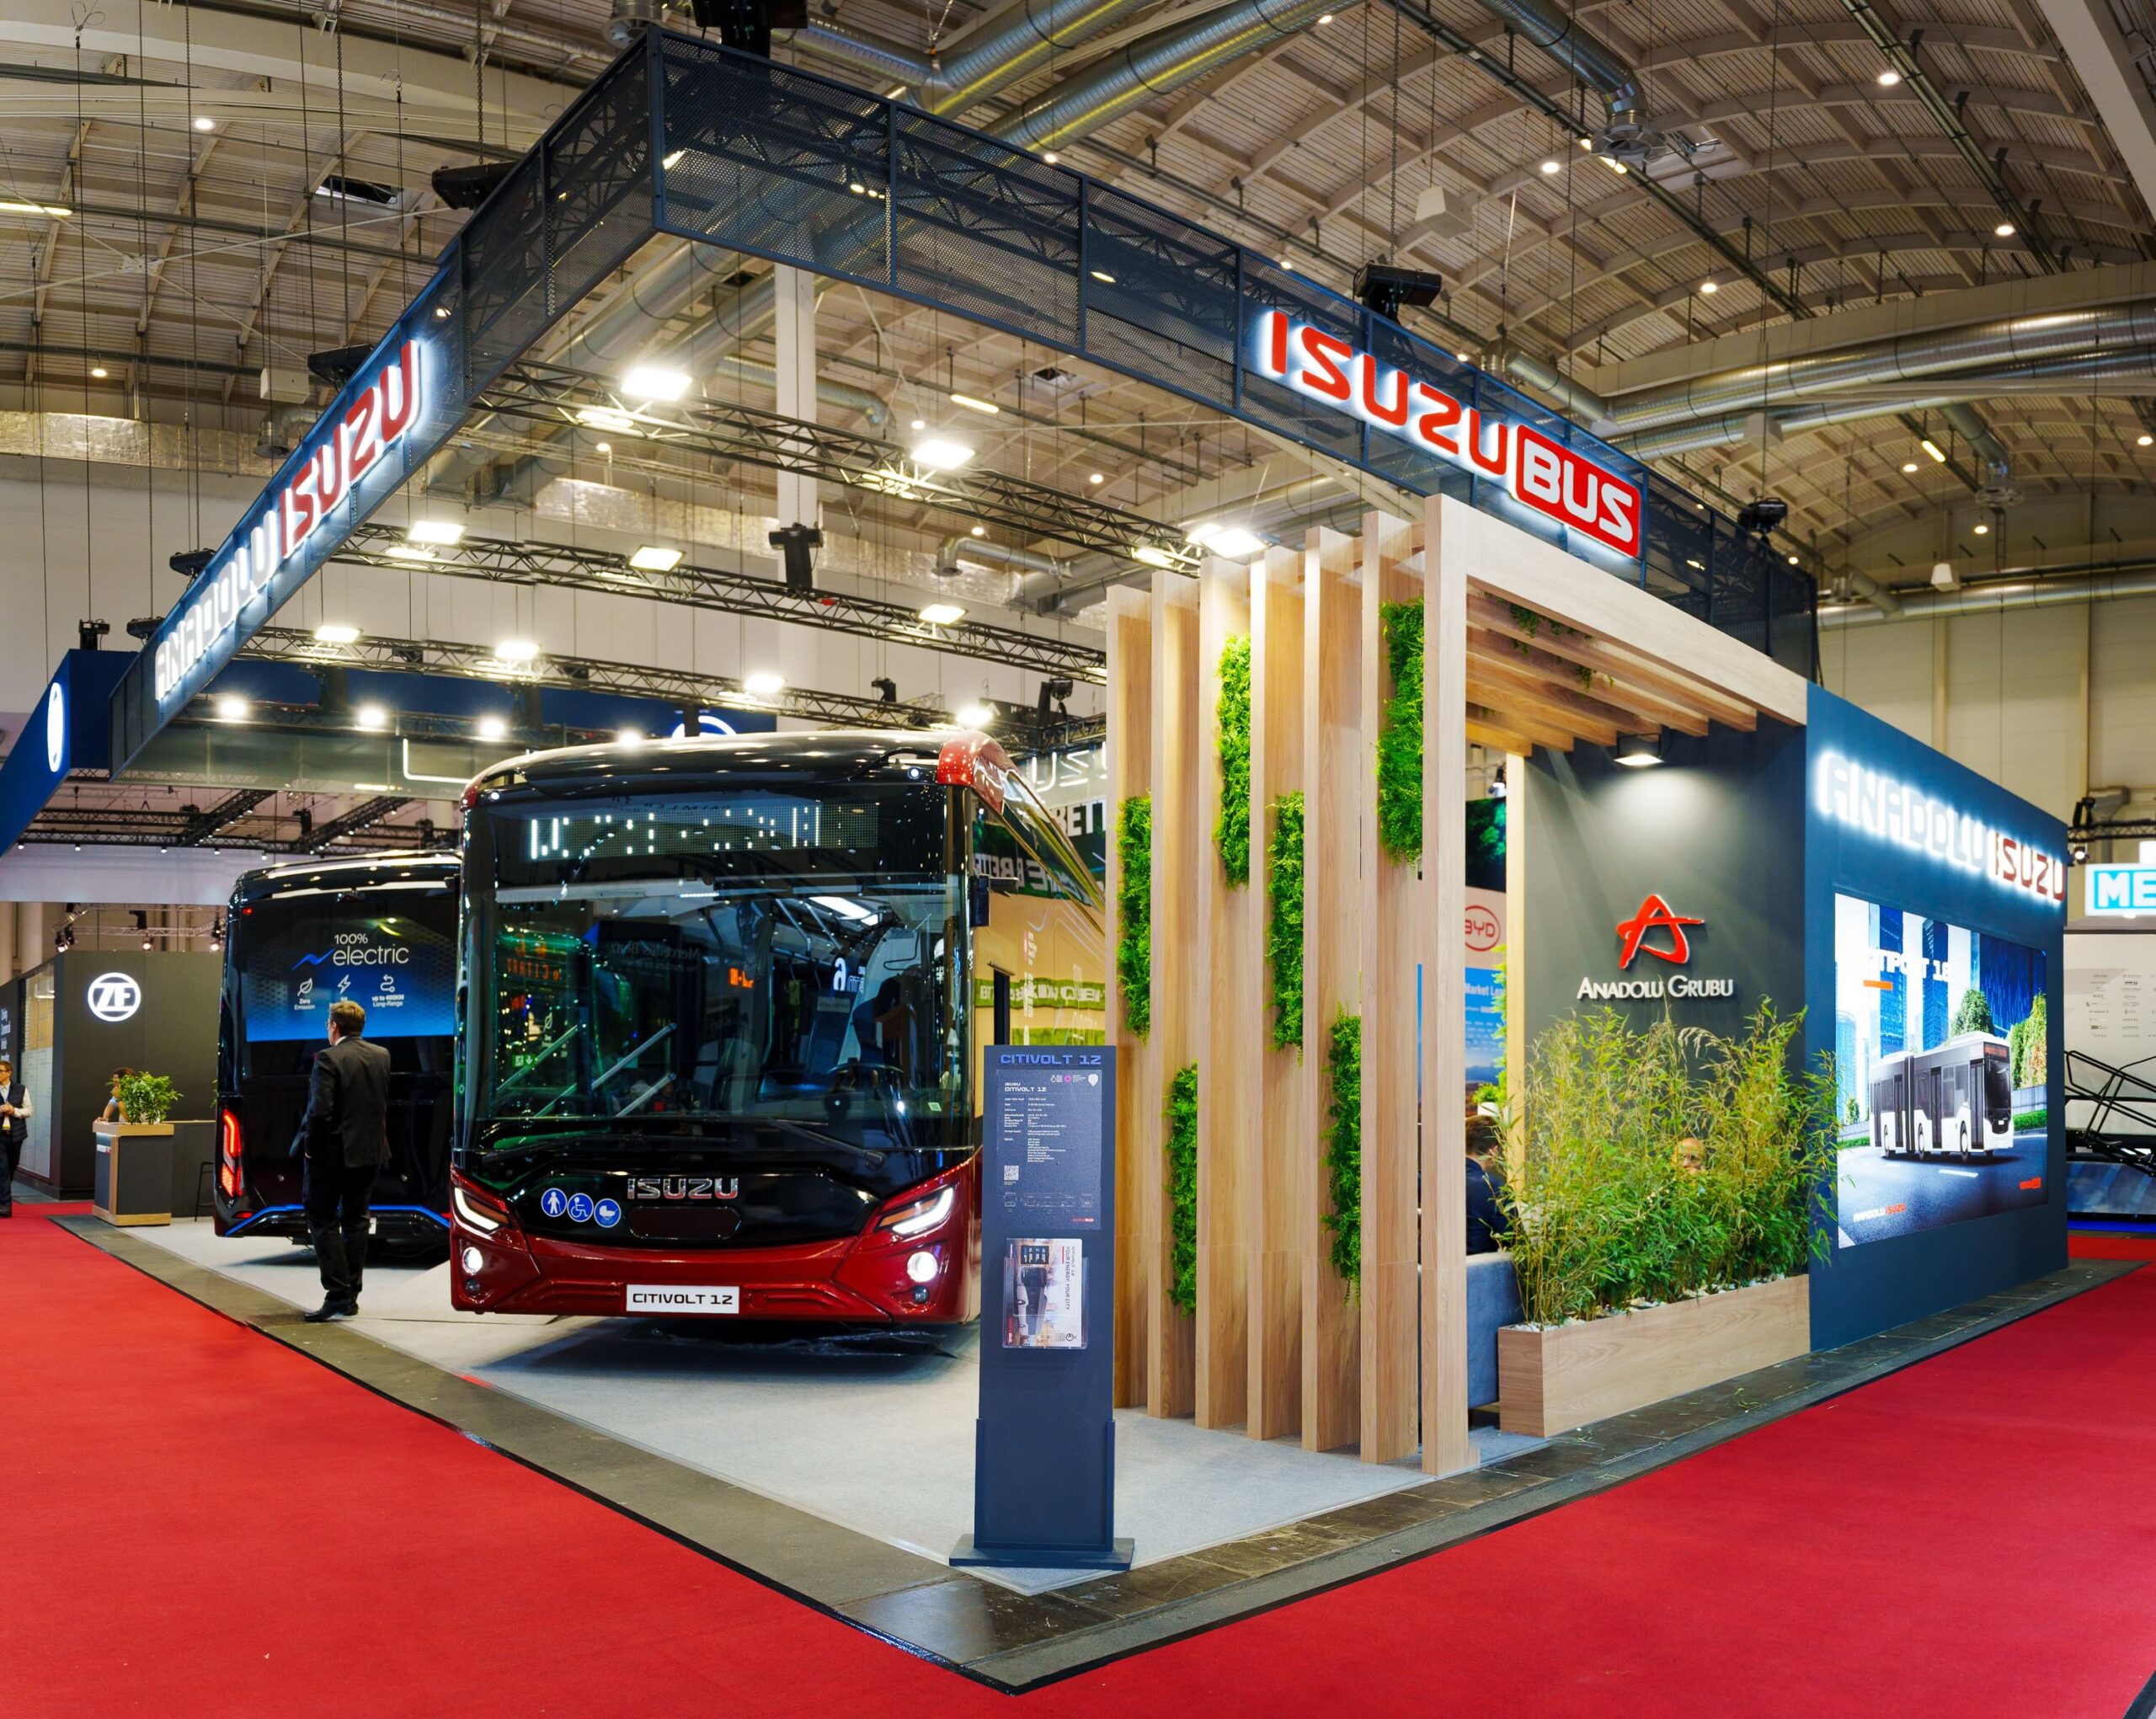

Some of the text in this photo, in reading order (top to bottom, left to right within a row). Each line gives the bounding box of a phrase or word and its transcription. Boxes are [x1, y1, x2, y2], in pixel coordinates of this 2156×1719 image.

[1267, 311, 1635, 543] ISUZU BUS
[154, 339, 421, 701] ANADOLU ISUZU
[1822, 755, 2067, 903] ANADOLU ISUZU
[334, 933, 368, 945] 100%
[1465, 919, 1496, 939] BYD
[333, 943, 409, 966] electric
[94, 981, 134, 1008] ZF
[1577, 974, 1735, 1001] ANADOLU GRUBU
[1000, 1054, 1102, 1065] CITIVOLT 12
[627, 1177, 739, 1199] ISUZU
[632, 1293, 734, 1305] CITIVOLT 12
